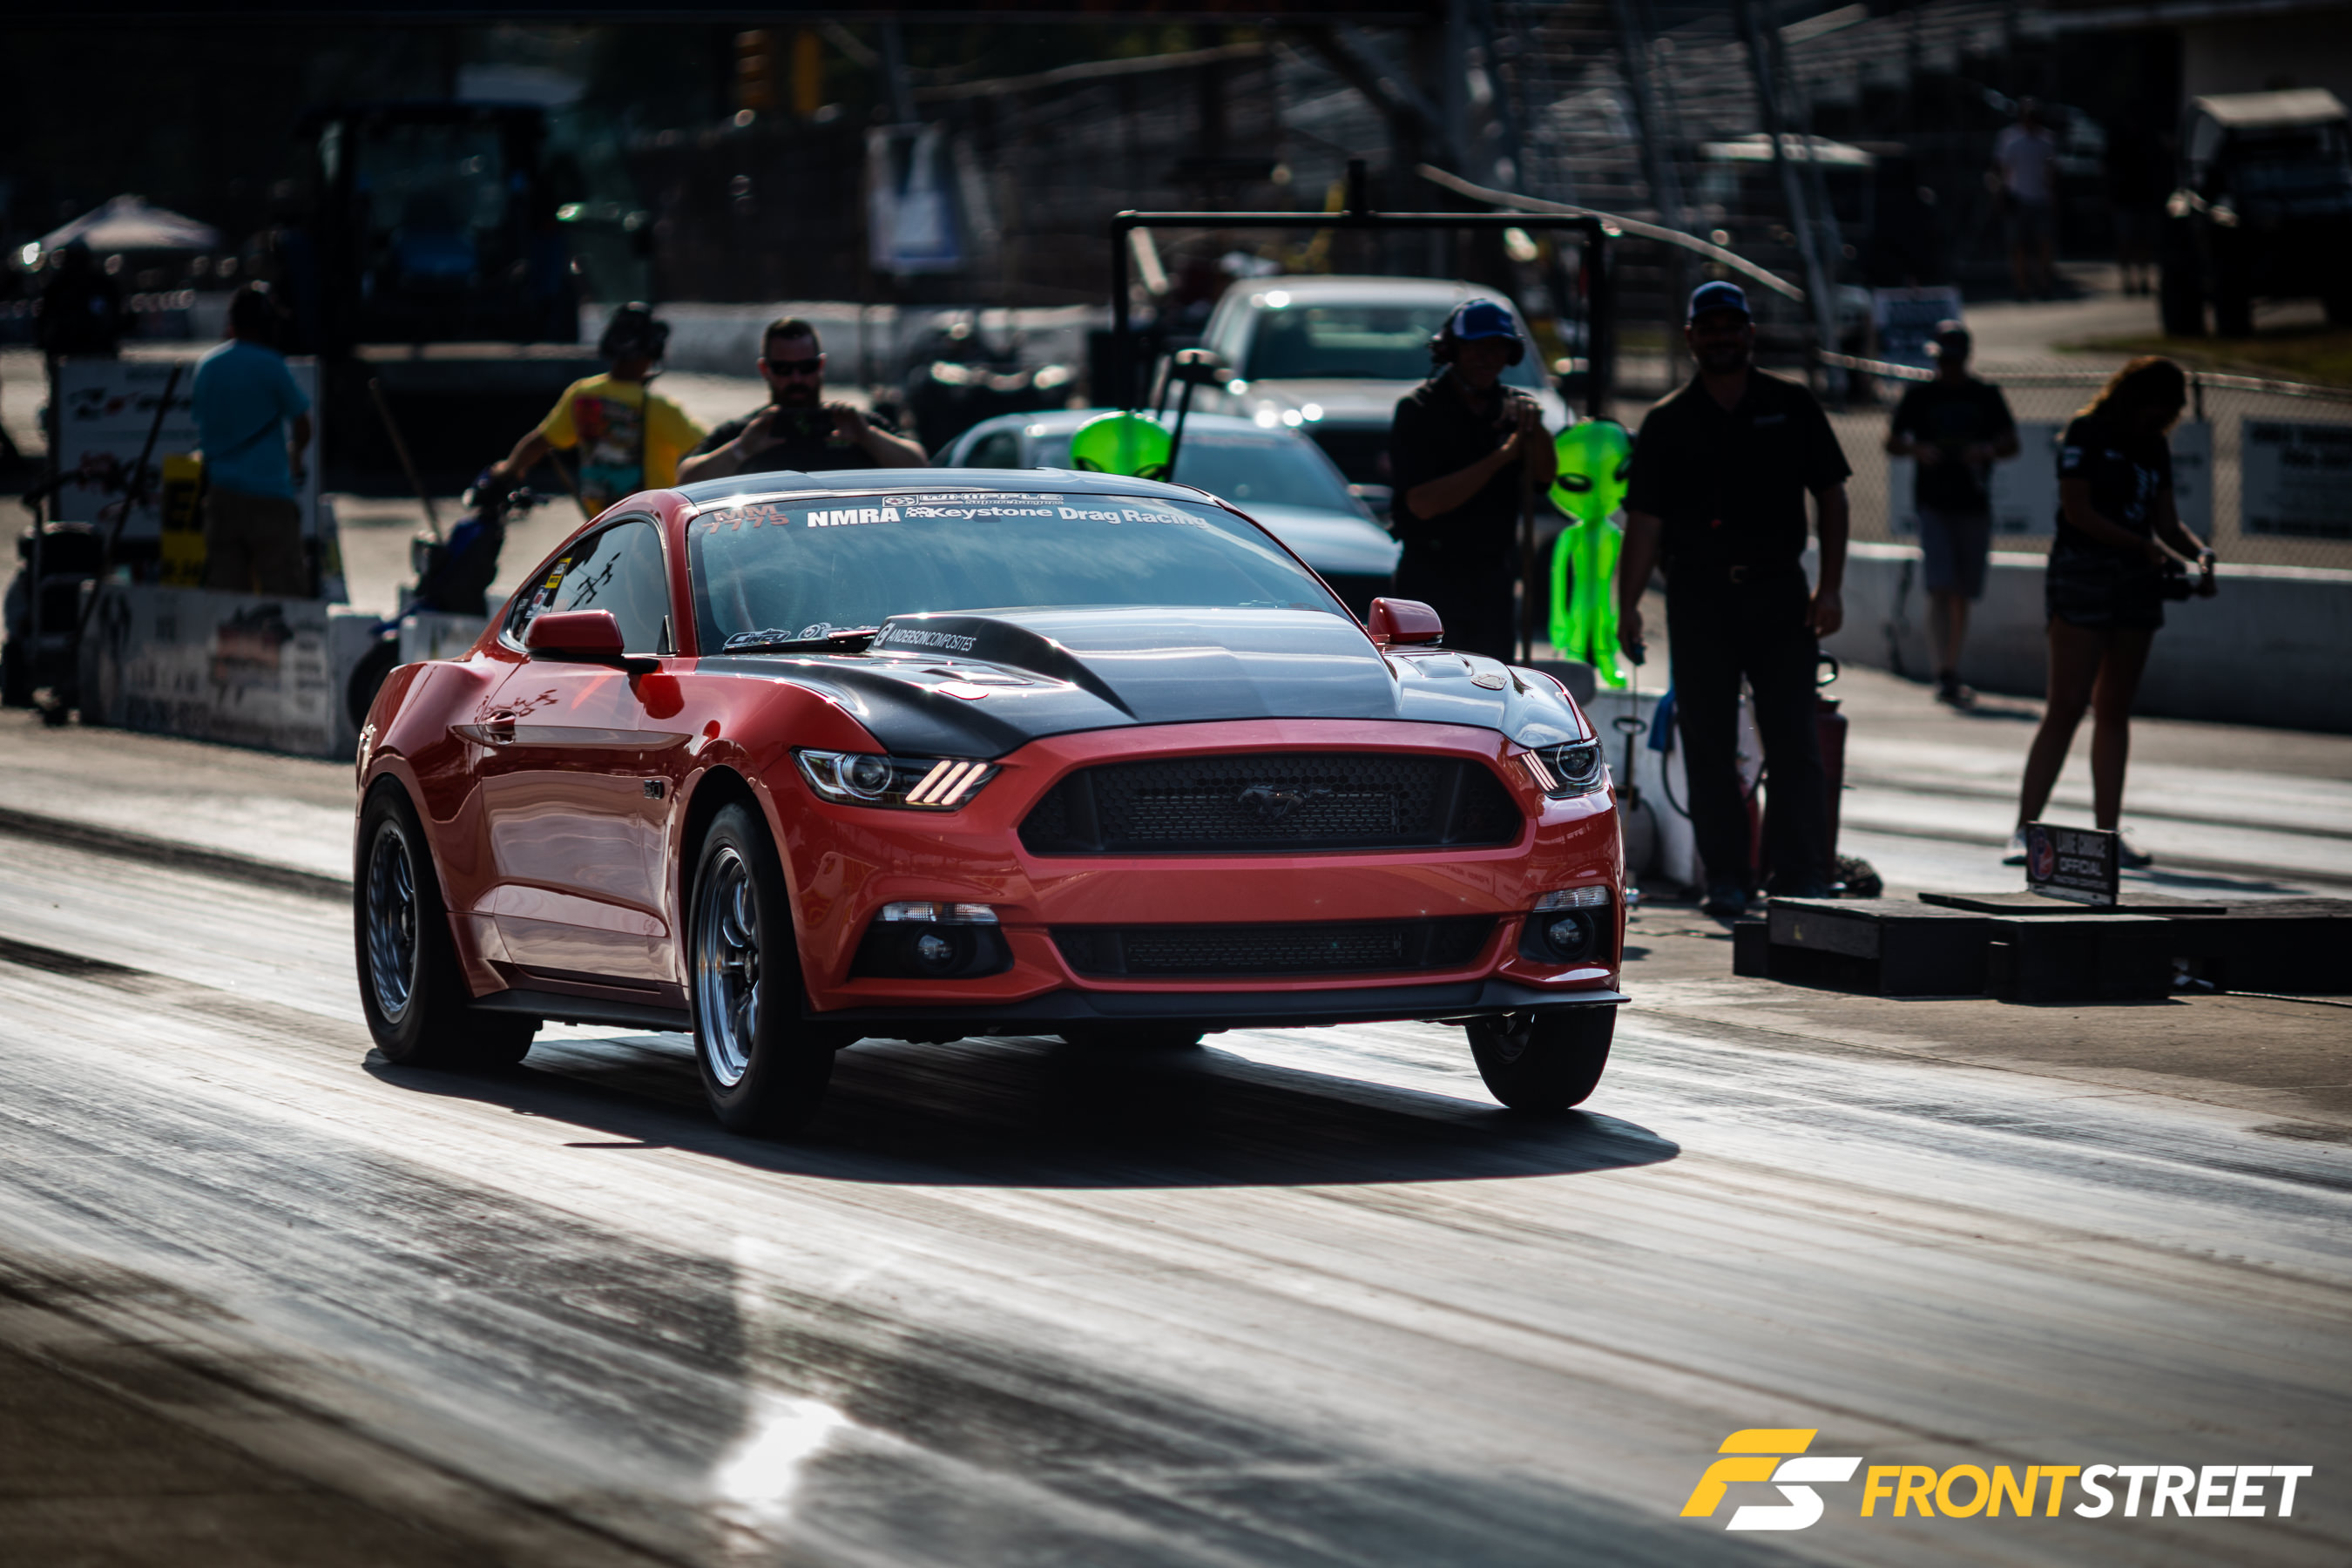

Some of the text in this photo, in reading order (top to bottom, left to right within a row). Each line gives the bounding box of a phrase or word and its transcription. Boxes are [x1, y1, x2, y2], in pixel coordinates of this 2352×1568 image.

[701, 514, 790, 534] 7775
[807, 506, 1211, 530] NMRA Keystone Drag Racing
[2059, 856, 2104, 877] OFFICIAL
